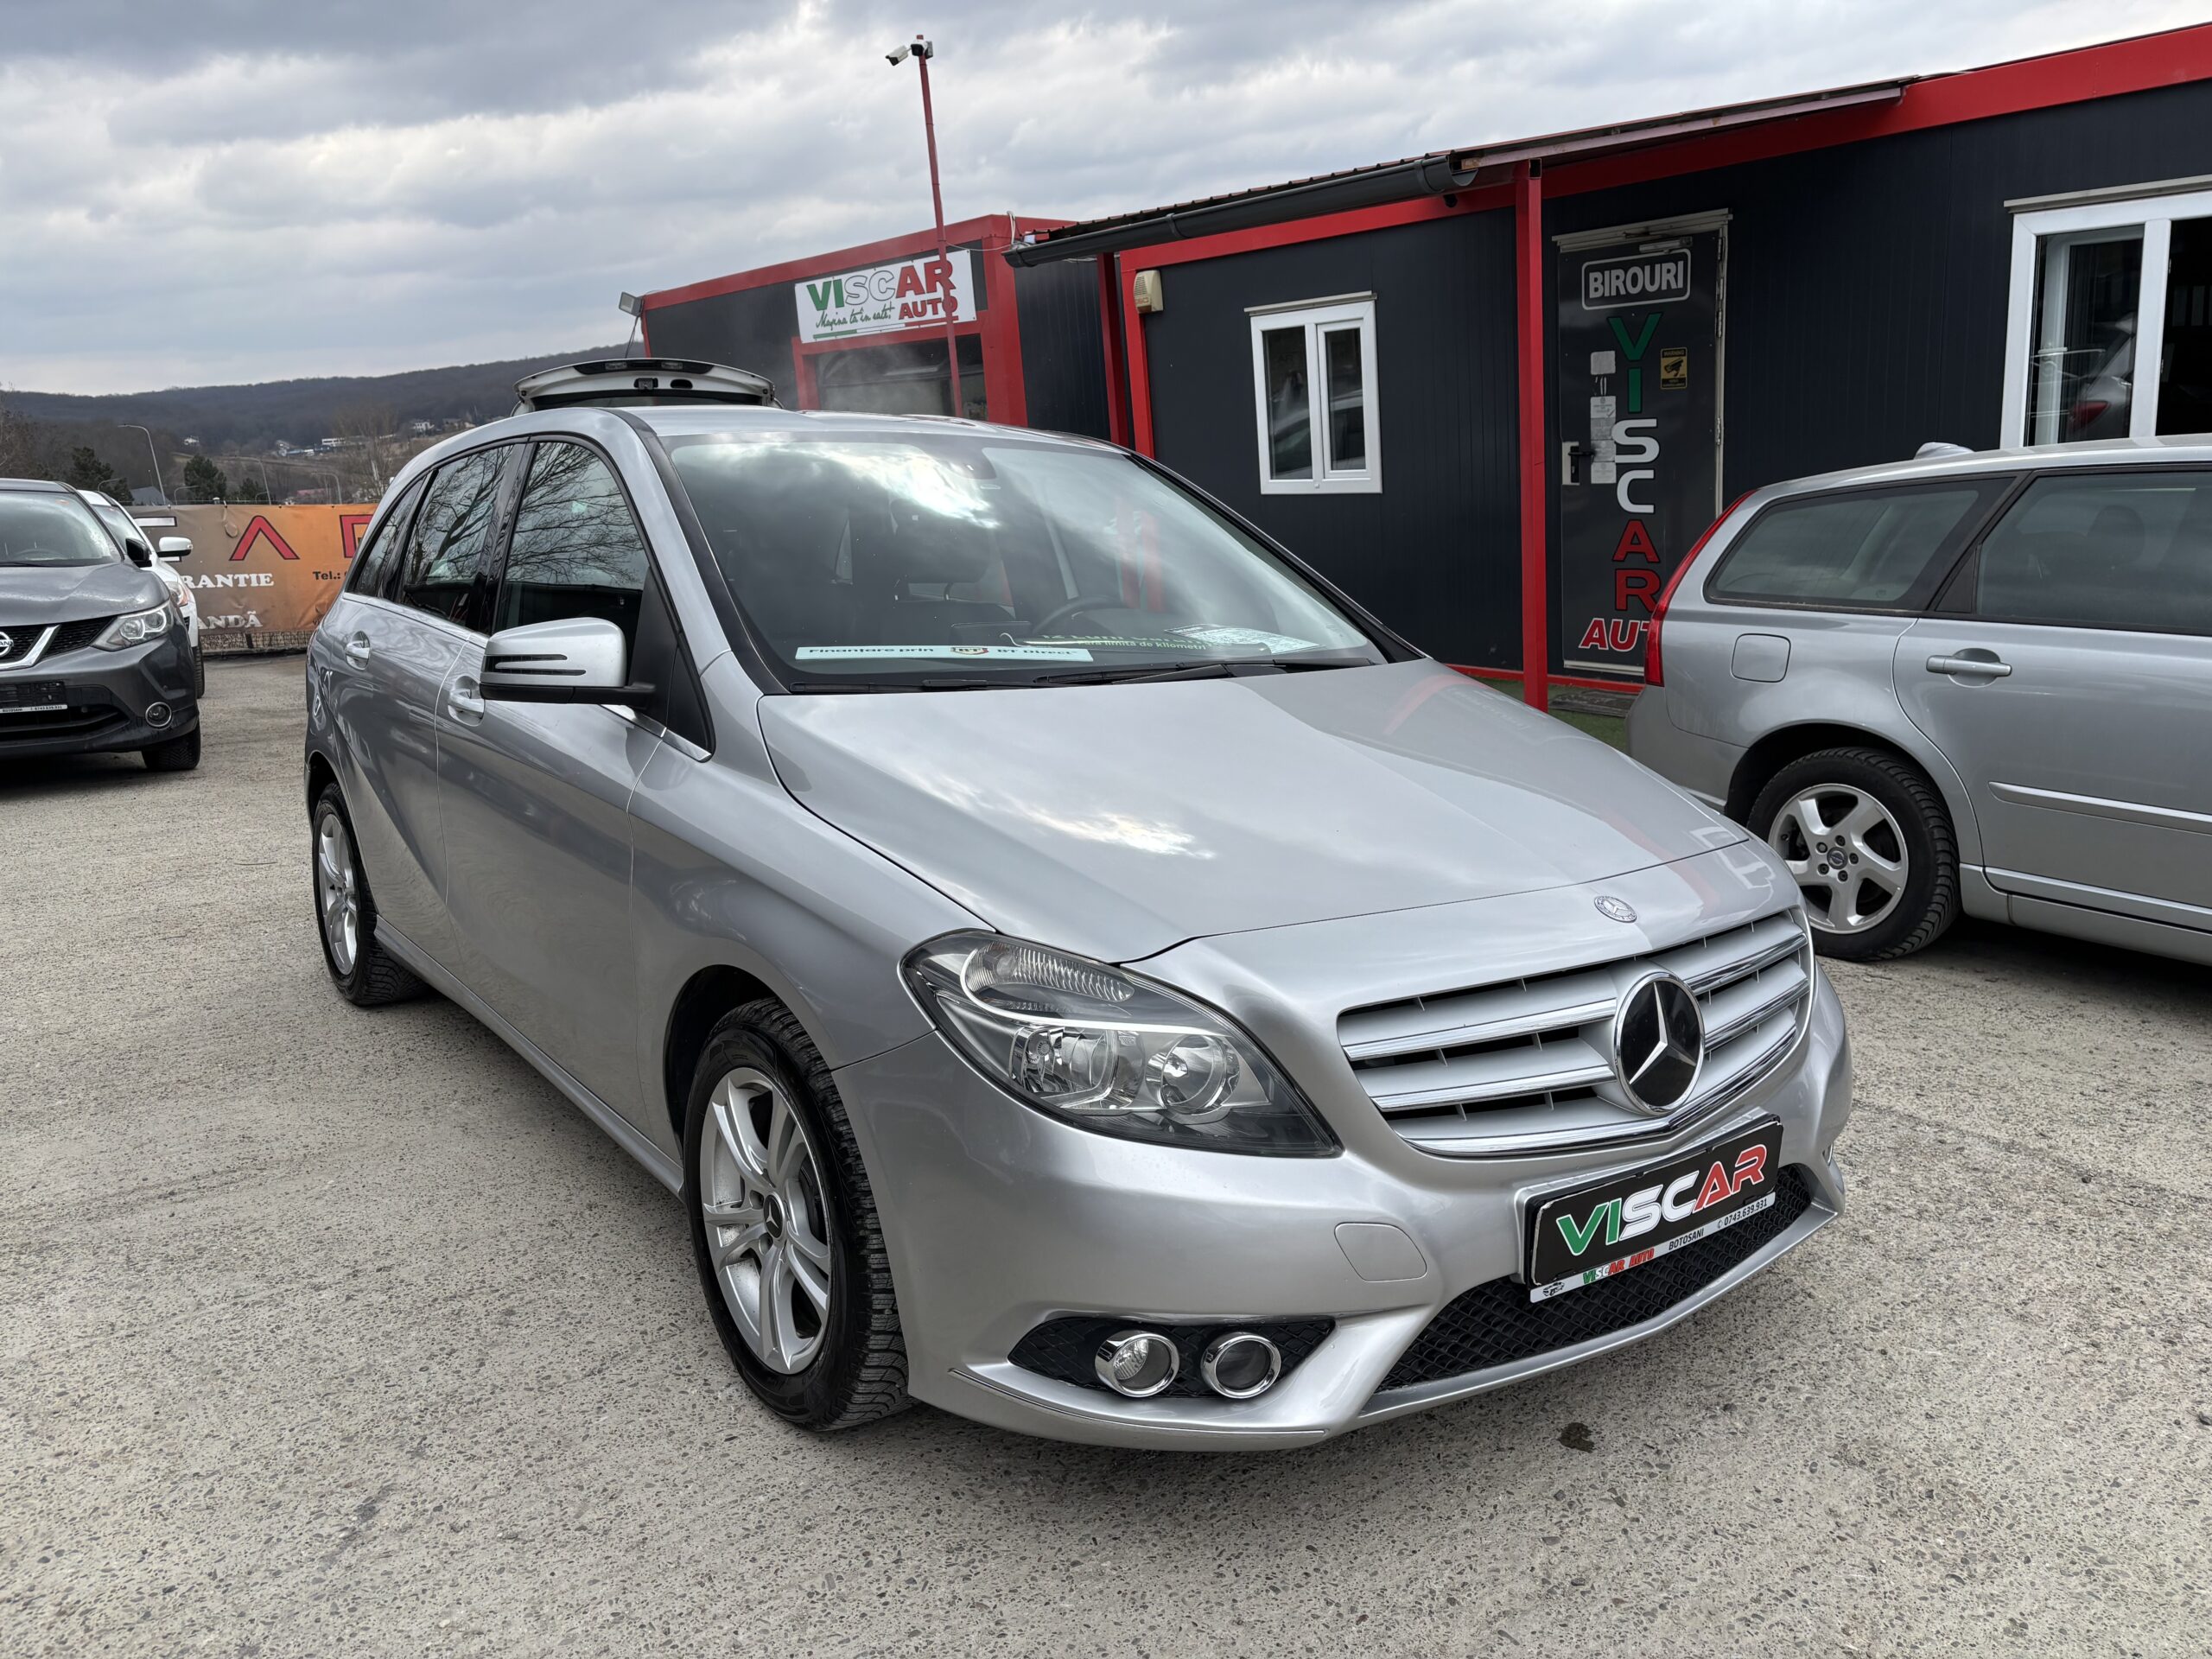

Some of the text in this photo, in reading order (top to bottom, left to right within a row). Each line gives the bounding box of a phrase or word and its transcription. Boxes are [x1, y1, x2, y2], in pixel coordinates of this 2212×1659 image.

[806, 259, 957, 312] VISCAR
[1589, 260, 1684, 299] BIROURI
[1607, 312, 1663, 613] VISCAR
[313, 571, 340, 580] Tel.:
[1556, 1144, 1767, 1255] VISCAR
[1582, 1198, 1768, 1285] VISCAR AUTO BOTOSANI 0743.639.931
